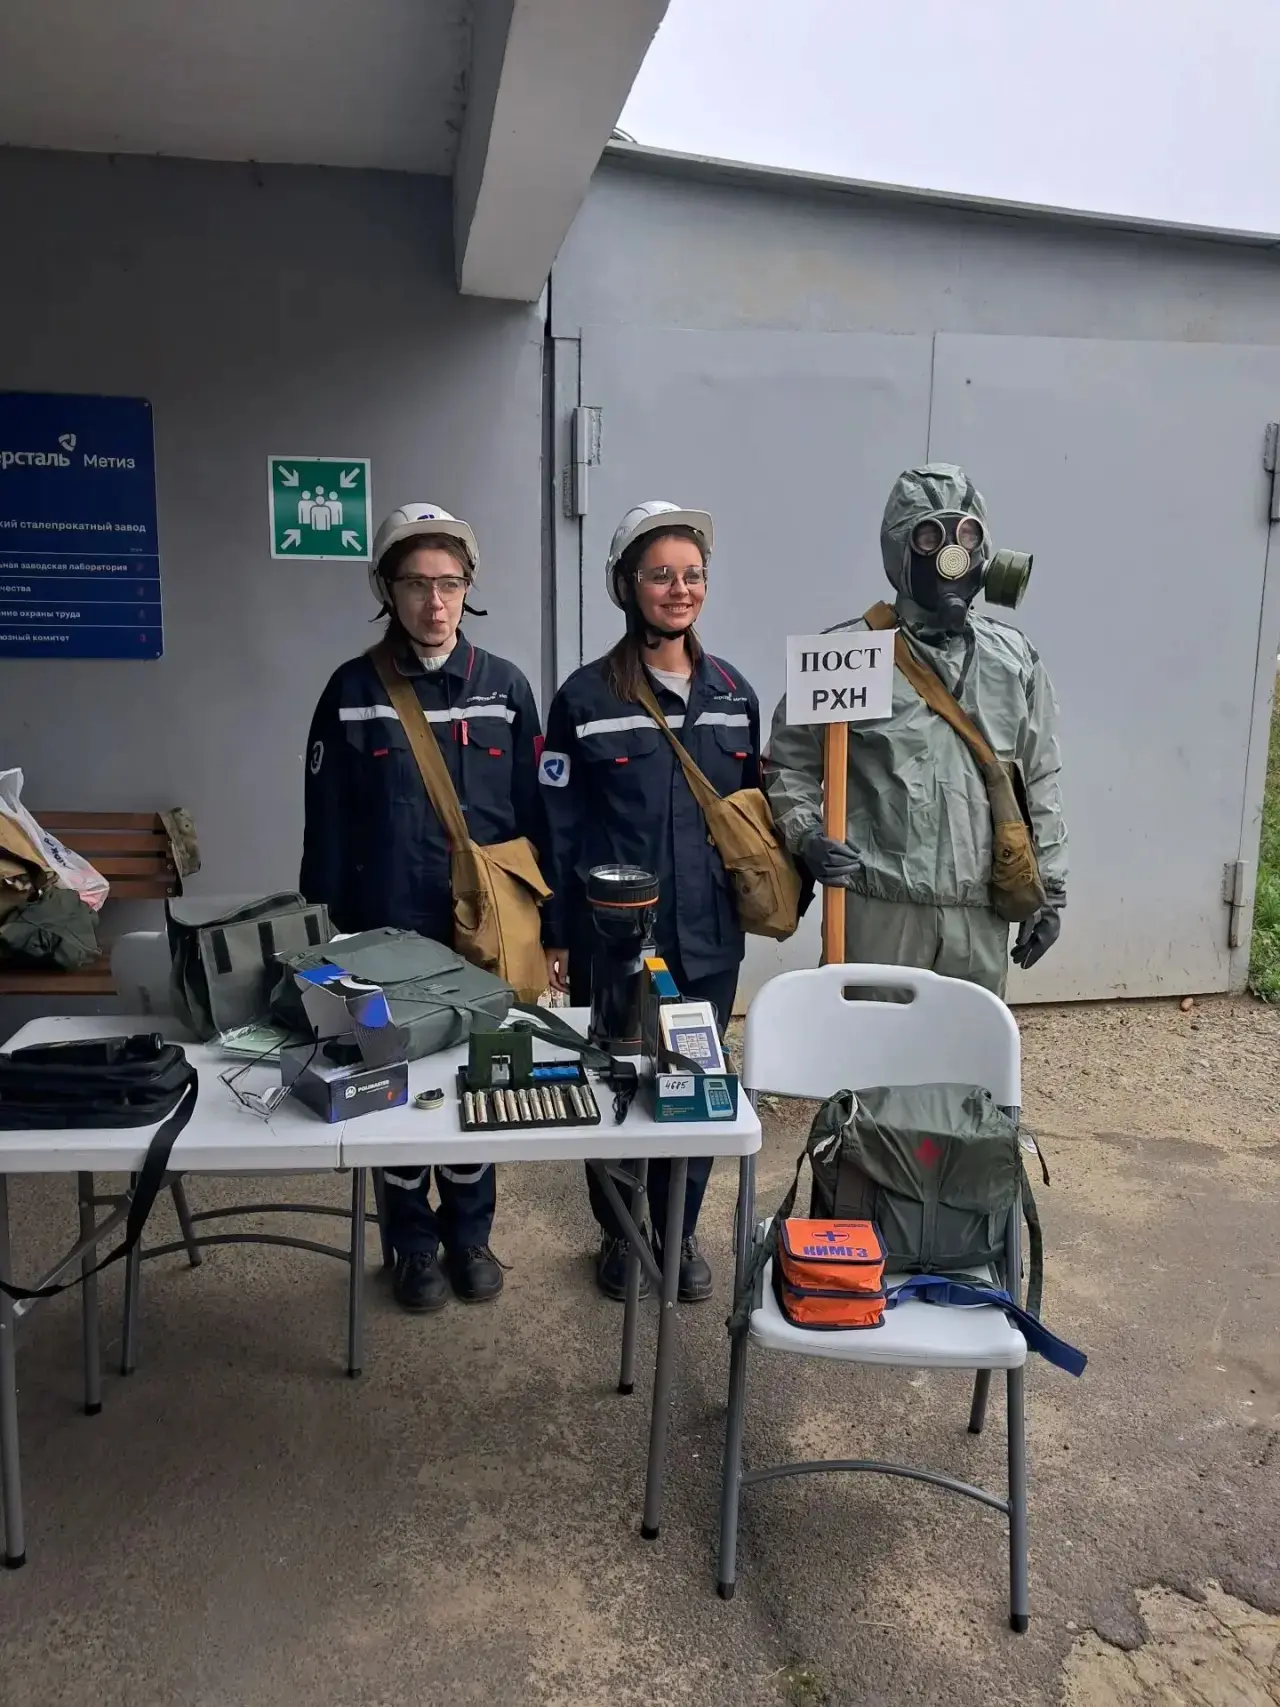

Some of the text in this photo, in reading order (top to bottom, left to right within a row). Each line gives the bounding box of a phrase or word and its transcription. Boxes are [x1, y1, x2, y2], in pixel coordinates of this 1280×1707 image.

[0, 451, 136, 470] рсталь Метиз
[20, 521, 113, 532] сталепрокатный
[115, 523, 147, 533] завод
[21, 562, 67, 571] заводская
[69, 562, 128, 572] лаборатория
[20, 610, 54, 619] охраны
[55, 611, 81, 620] труда
[800, 647, 882, 672] ПОСТ
[812, 686, 867, 711] РХН
[358, 1080, 389, 1092] POLIMASTER
[803, 1245, 868, 1258] КИМГЗ
